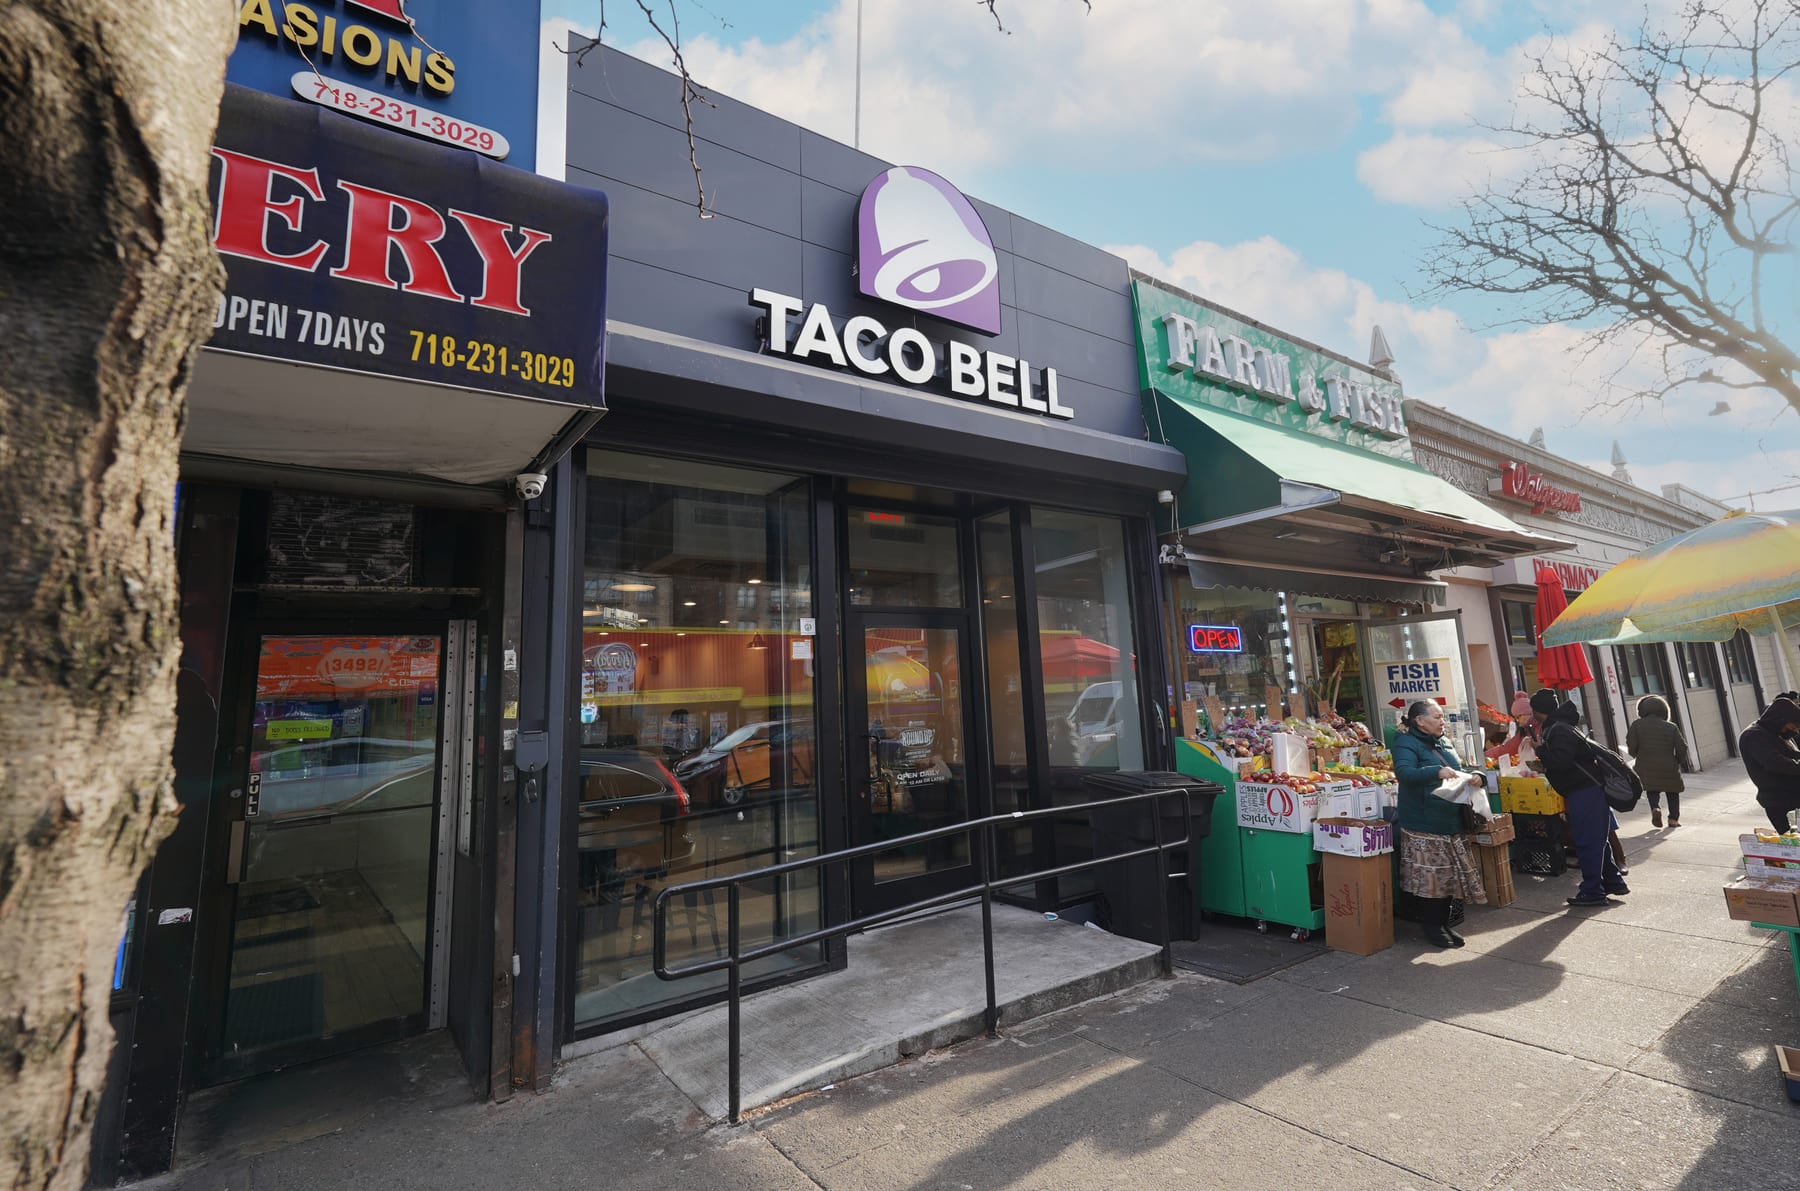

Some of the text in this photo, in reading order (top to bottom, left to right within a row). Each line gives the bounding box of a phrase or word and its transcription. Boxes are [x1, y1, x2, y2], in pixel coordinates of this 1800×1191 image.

[240, 0, 455, 94] ASIONS
[313, 82, 494, 151] 718-231-3029
[211, 146, 552, 317] ERY
[211, 294, 386, 355] OPEN 7DAYS
[409, 330, 575, 388] 718-231-3029
[752, 287, 1075, 420] TACO BELL
[1161, 312, 1407, 442] FARM & FISH
[1193, 629, 1239, 650] OPEN
[1387, 662, 1440, 681] FISH
[1389, 680, 1441, 694] MARKET
[902, 730, 923, 747] ROUND
[247, 775, 261, 816] PULL
[896, 768, 941, 781] OPEN DAILY
[1241, 812, 1276, 826] Apples
